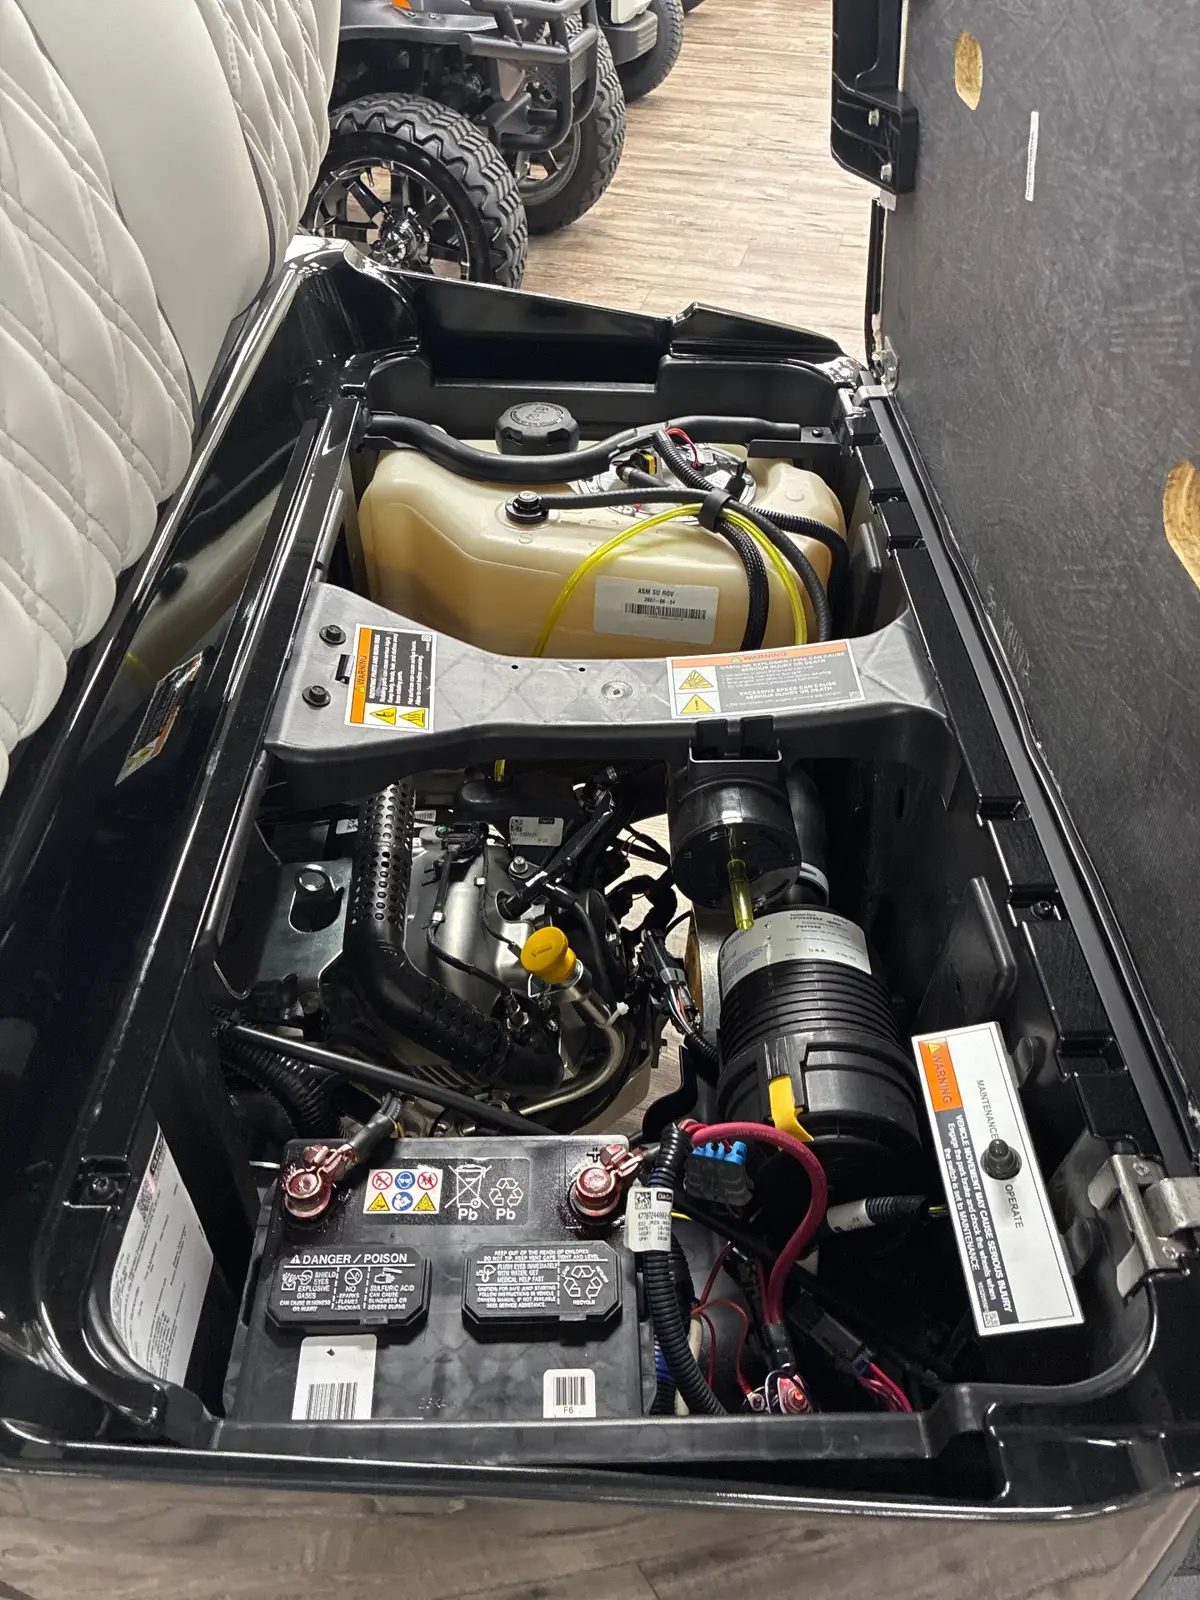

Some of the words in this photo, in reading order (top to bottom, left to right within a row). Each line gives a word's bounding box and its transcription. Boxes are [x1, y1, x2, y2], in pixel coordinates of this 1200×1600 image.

[357, 655, 367, 684] WARNING
[932, 1054, 953, 1104] WARNING
[977, 1078, 999, 1140] MAINTENANCE
[947, 1122, 960, 1149] Engage
[956, 1114, 969, 1147] VEHICLE
[947, 1159, 958, 1181] switch
[957, 1160, 966, 1177] park
[964, 1146, 981, 1191] MOVEMENT
[961, 1176, 972, 1198] brake
[957, 1202, 964, 1210] to
[967, 1197, 975, 1213] and
[976, 1191, 985, 1210] MAY
[1006, 1183, 1023, 1229] OPERATE
[458, 1208, 478, 1220] Pb
[496, 1208, 516, 1220] Pb
[970, 1212, 981, 1236] chock
[980, 1209, 992, 1239] CAUSE
[959, 1210, 980, 1272] MAINTENANCE
[976, 1235, 984, 1249] the
[302, 1254, 351, 1264] DANGER
[353, 1254, 362, 1264] /
[364, 1253, 408, 1263] POISON
[979, 1249, 991, 1277] wheels
[987, 1239, 1003, 1279] SERIOUS
[986, 1277, 997, 1300] when
[998, 1279, 1012, 1313] INJURY
